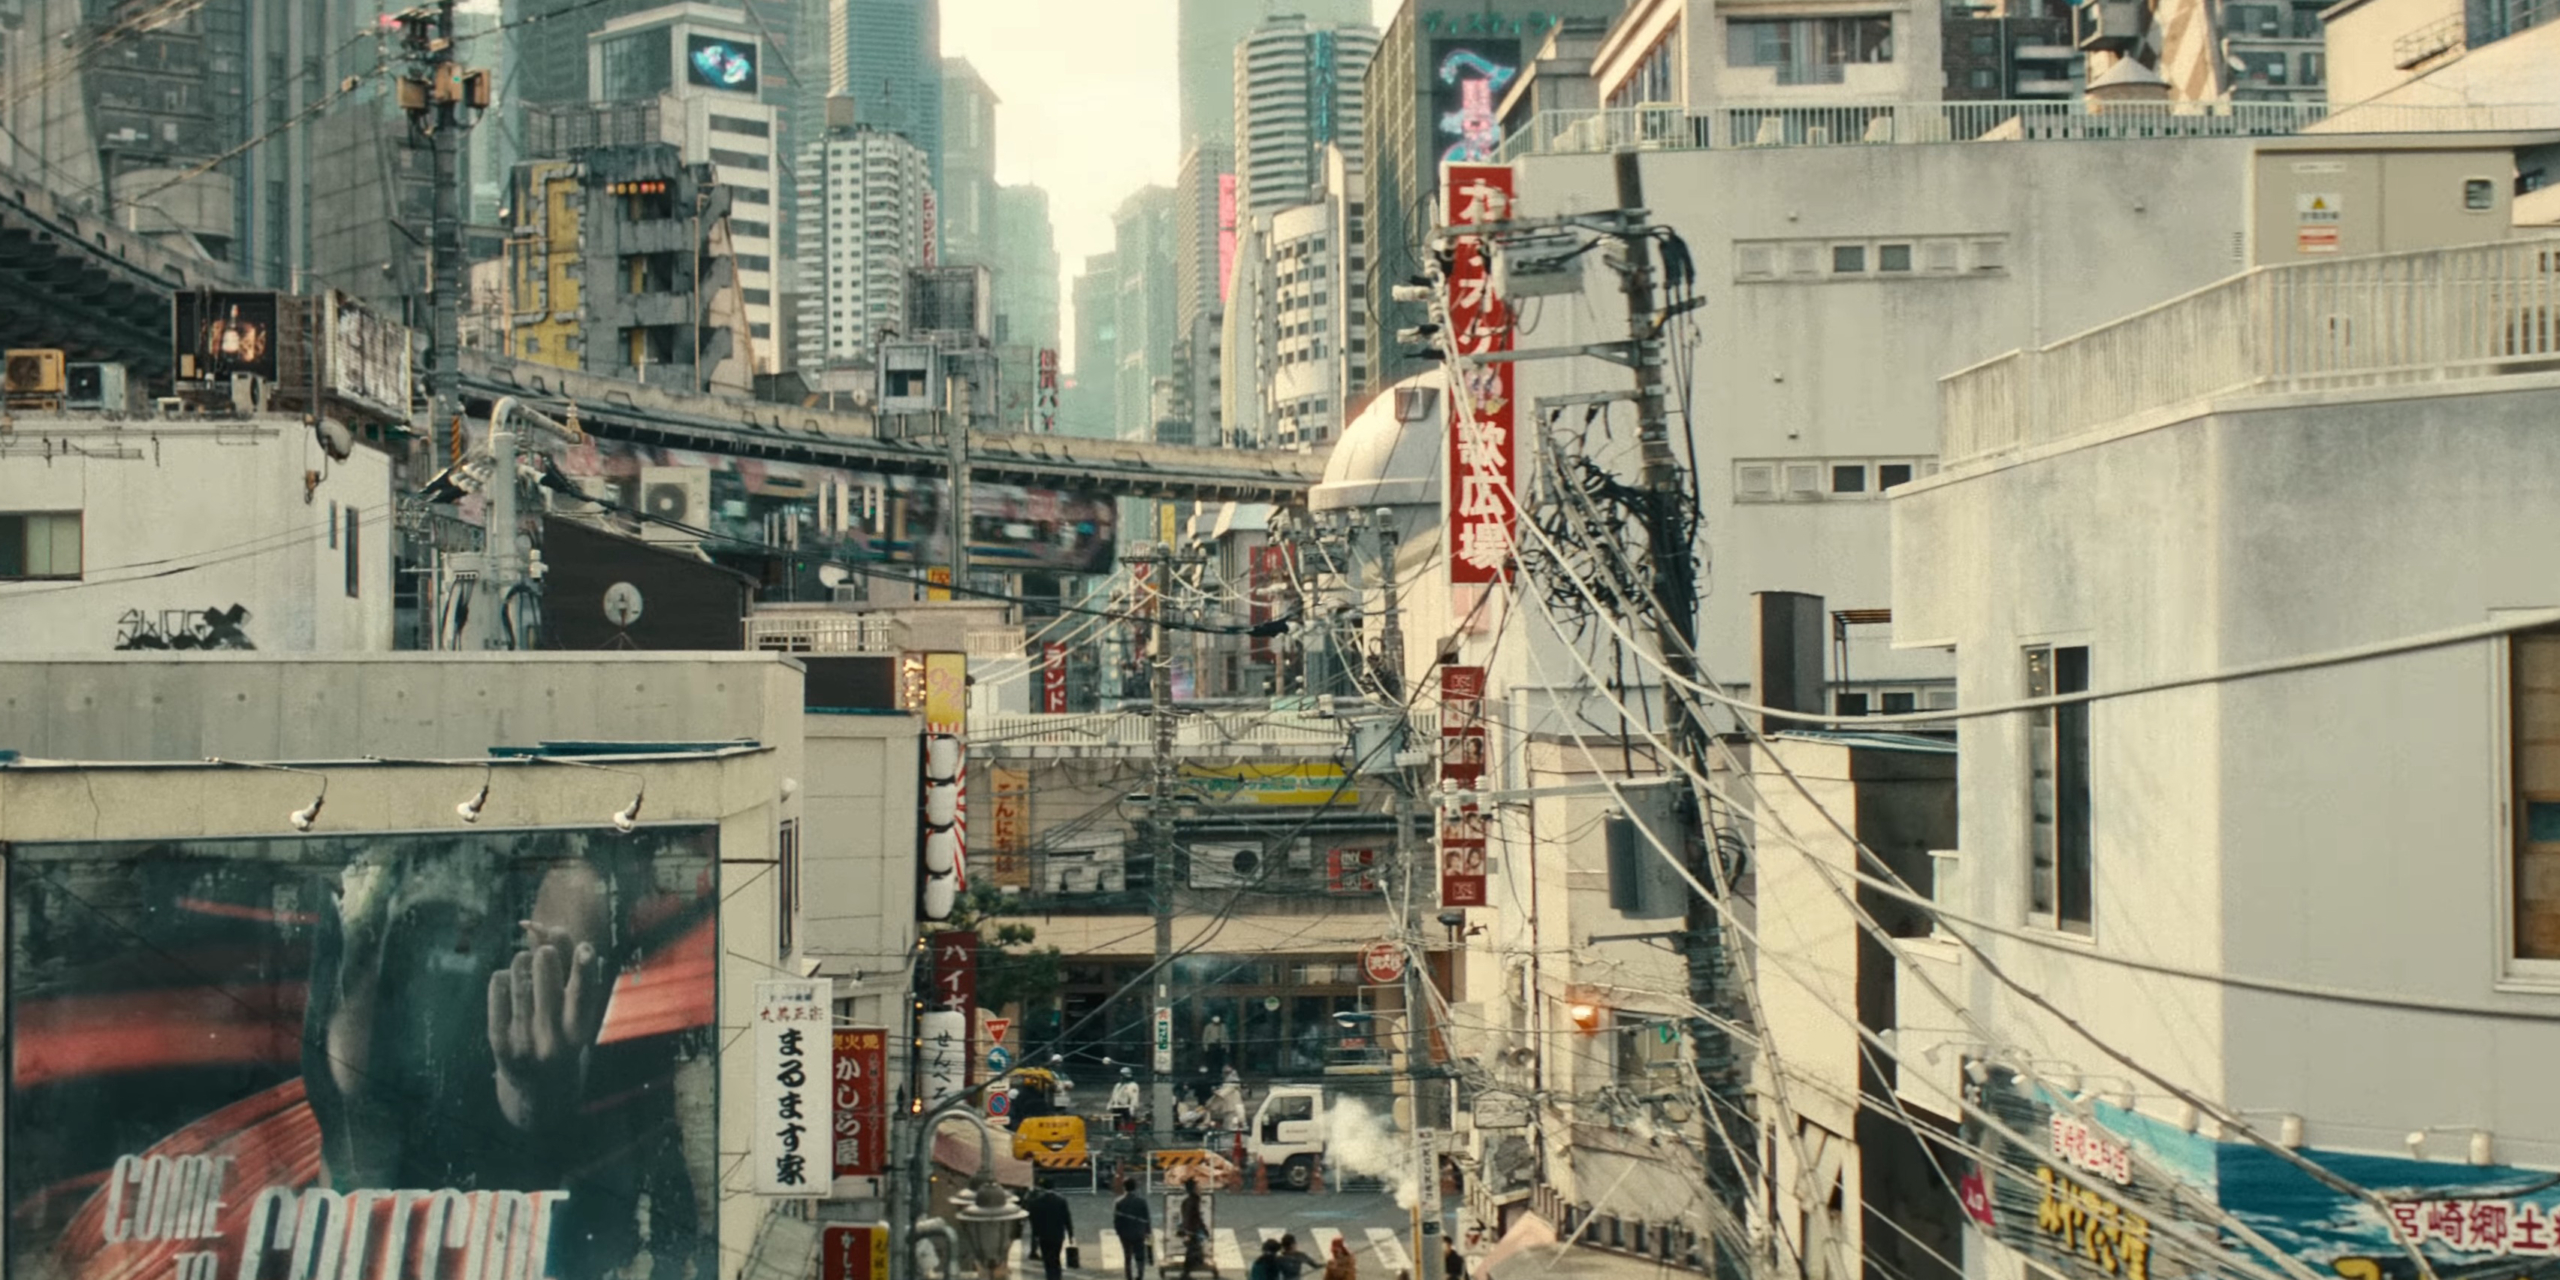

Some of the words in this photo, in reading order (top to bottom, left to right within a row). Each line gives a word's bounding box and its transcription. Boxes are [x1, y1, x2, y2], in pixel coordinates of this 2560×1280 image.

[1457, 421, 1508, 570] 歌広場
[776, 1028, 807, 1186] まるます家
[835, 1056, 861, 1167] かしら屋
[103, 1154, 235, 1244] COME
[2391, 1201, 2560, 1248] 宮崎郷土
